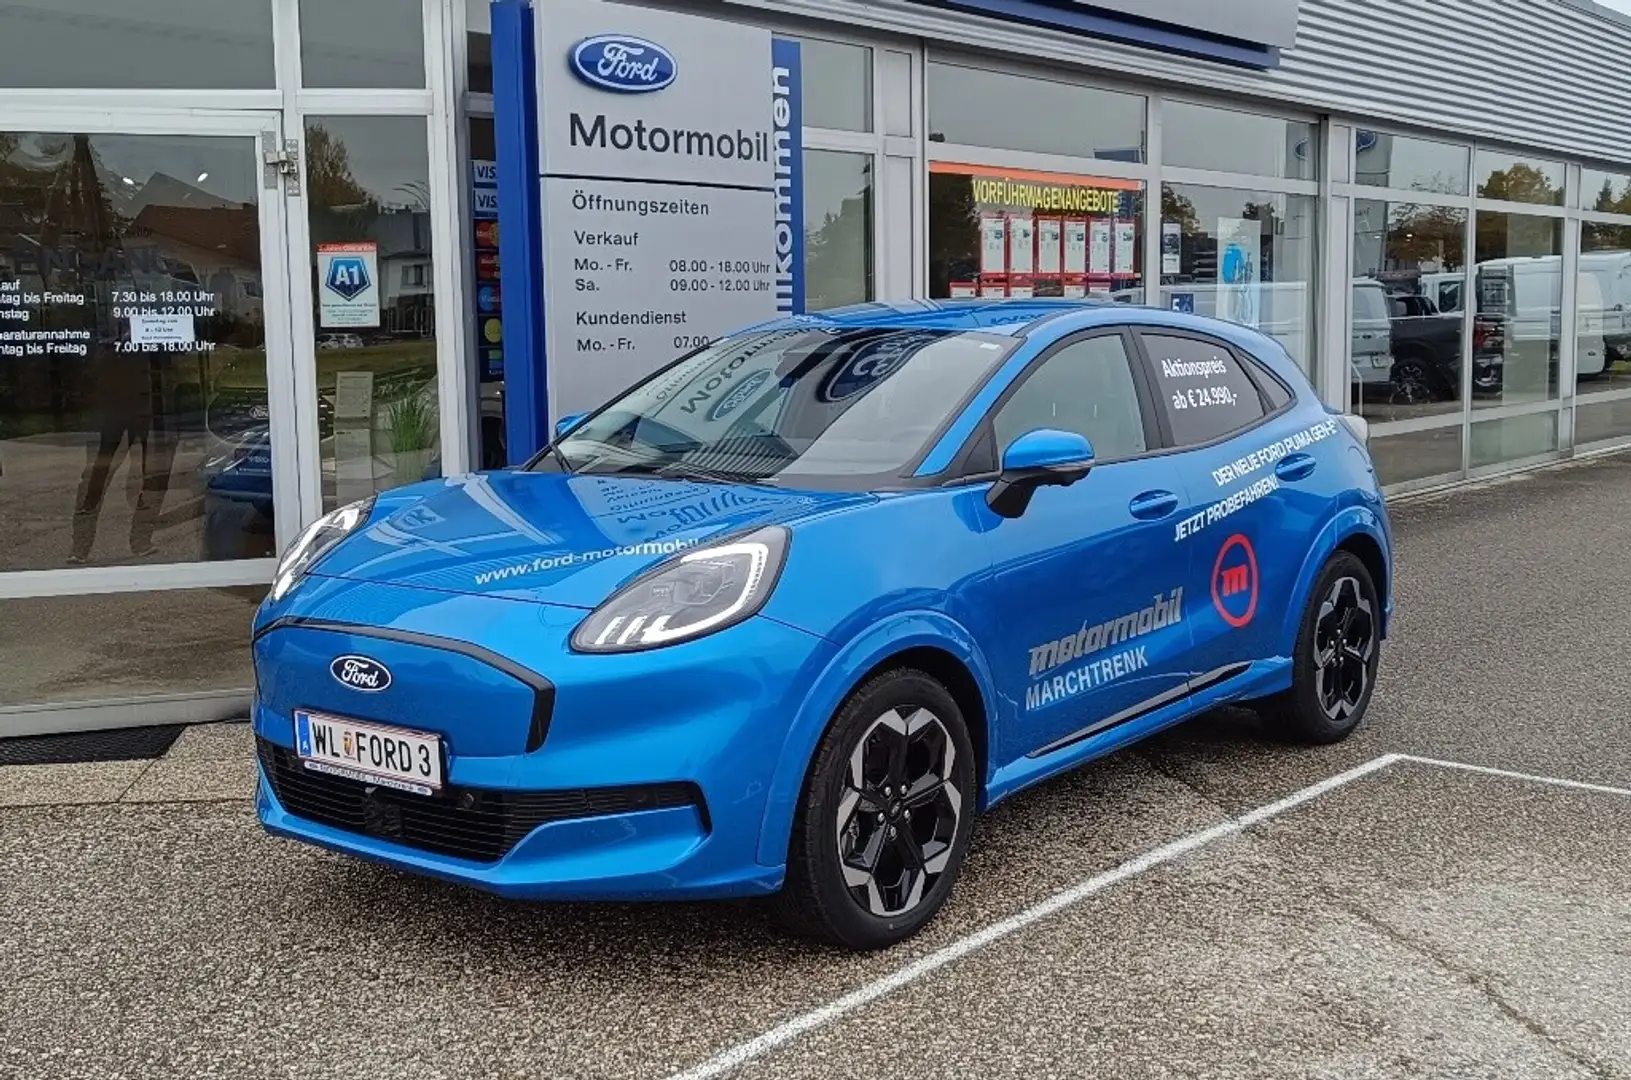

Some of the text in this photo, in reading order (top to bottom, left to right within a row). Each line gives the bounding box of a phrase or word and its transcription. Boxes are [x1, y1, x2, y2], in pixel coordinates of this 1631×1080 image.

[598, 43, 659, 81] Ford
[570, 112, 768, 162] Motormobil
[476, 165, 497, 179] VIS
[477, 195, 497, 208] VIS
[572, 189, 709, 216] Öffnungszeiten
[972, 177, 1119, 213] VORFÜHRWAGENANGEBOTE
[574, 230, 639, 246] Verkauf
[335, 265, 360, 285] A1
[574, 258, 604, 271] Mo.
[615, 258, 633, 271] Fr.
[669, 260, 707, 273] 08.00
[718, 261, 750, 273] 18.00
[752, 261, 770, 274] Uhr
[0, 279, 20, 291] auf
[575, 278, 600, 291] Sa.
[670, 278, 708, 291] 09.00
[719, 279, 750, 291] 12.00
[753, 280, 770, 291] Uhr
[0, 291, 214, 306] tag bis Freitag 7.30 bis 18.00 Uhr
[161, 305, 192, 316] 1200
[194, 306, 215, 316] Uhr
[576, 310, 687, 325] Kundendienst
[26, 342, 44, 354] bis
[46, 342, 88, 356] Freitag
[195, 340, 216, 351] Uhr
[577, 338, 606, 351] Mo.
[618, 338, 636, 350] Fr.
[673, 335, 710, 348] 07.00
[1161, 356, 1227, 378] Aktionspreis
[1172, 389, 1187, 409] ab
[1187, 389, 1198, 407] €
[1211, 464, 1238, 487] DER
[1231, 451, 1261, 477] NEUE
[1256, 441, 1287, 466] FORD
[1283, 431, 1314, 453] PUMA
[1174, 511, 1206, 542] JETZT
[1029, 586, 1184, 676] motormobil
[342, 660, 379, 687] Ford
[1025, 645, 1149, 711] MARCHTRENK
[312, 722, 432, 777] WL FORD 3
